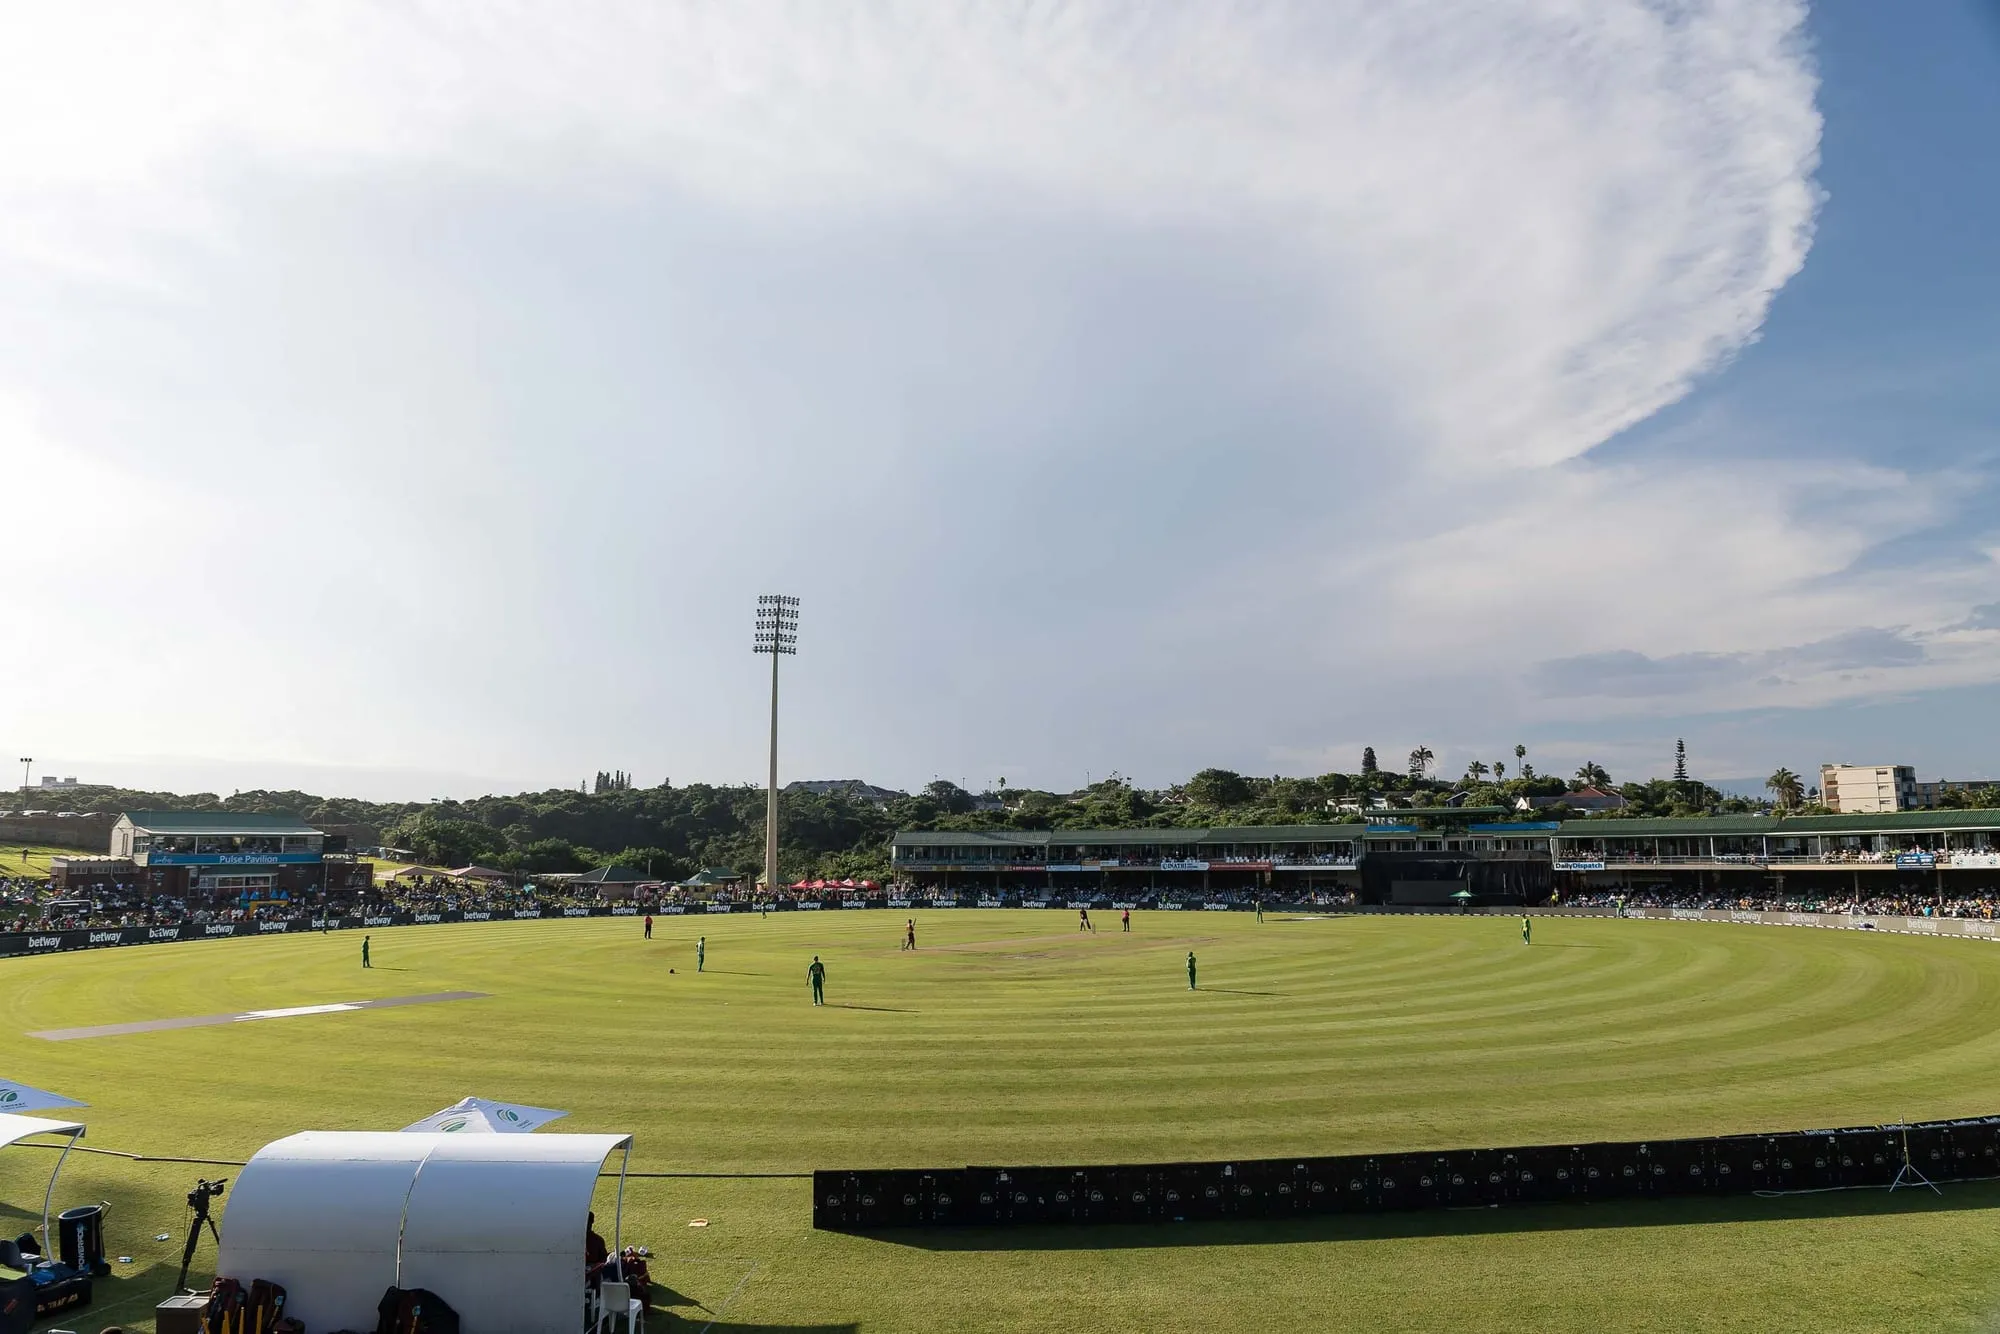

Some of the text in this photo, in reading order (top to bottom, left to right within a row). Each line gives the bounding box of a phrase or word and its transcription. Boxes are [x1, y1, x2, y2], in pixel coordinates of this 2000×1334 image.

[245, 855, 278, 863] Pavilion
[798, 900, 821, 908] betway
[843, 899, 866, 908] betway
[888, 899, 911, 908] betway
[933, 899, 956, 907] betway
[978, 899, 1001, 908] betway
[1022, 900, 1046, 908] betway
[1067, 901, 1091, 910] betway
[1113, 902, 1136, 910] betway
[564, 908, 590, 916] betway
[612, 906, 638, 915] betway
[660, 904, 685, 914] betway
[707, 904, 731, 912] betway
[415, 913, 441, 922] betway
[464, 911, 491, 920] betway
[515, 910, 541, 918] betway
[1672, 908, 1703, 919] betway
[1731, 911, 1761, 922] betway
[312, 918, 340, 928] betay
[364, 916, 391, 926] betway
[1790, 912, 1821, 925] betway
[206, 924, 235, 934] betway
[260, 921, 288, 931] betway
[1907, 918, 1938, 931] betway
[1964, 921, 1995, 937] betway
[28, 936, 61, 948] betway
[89, 932, 121, 944] betway
